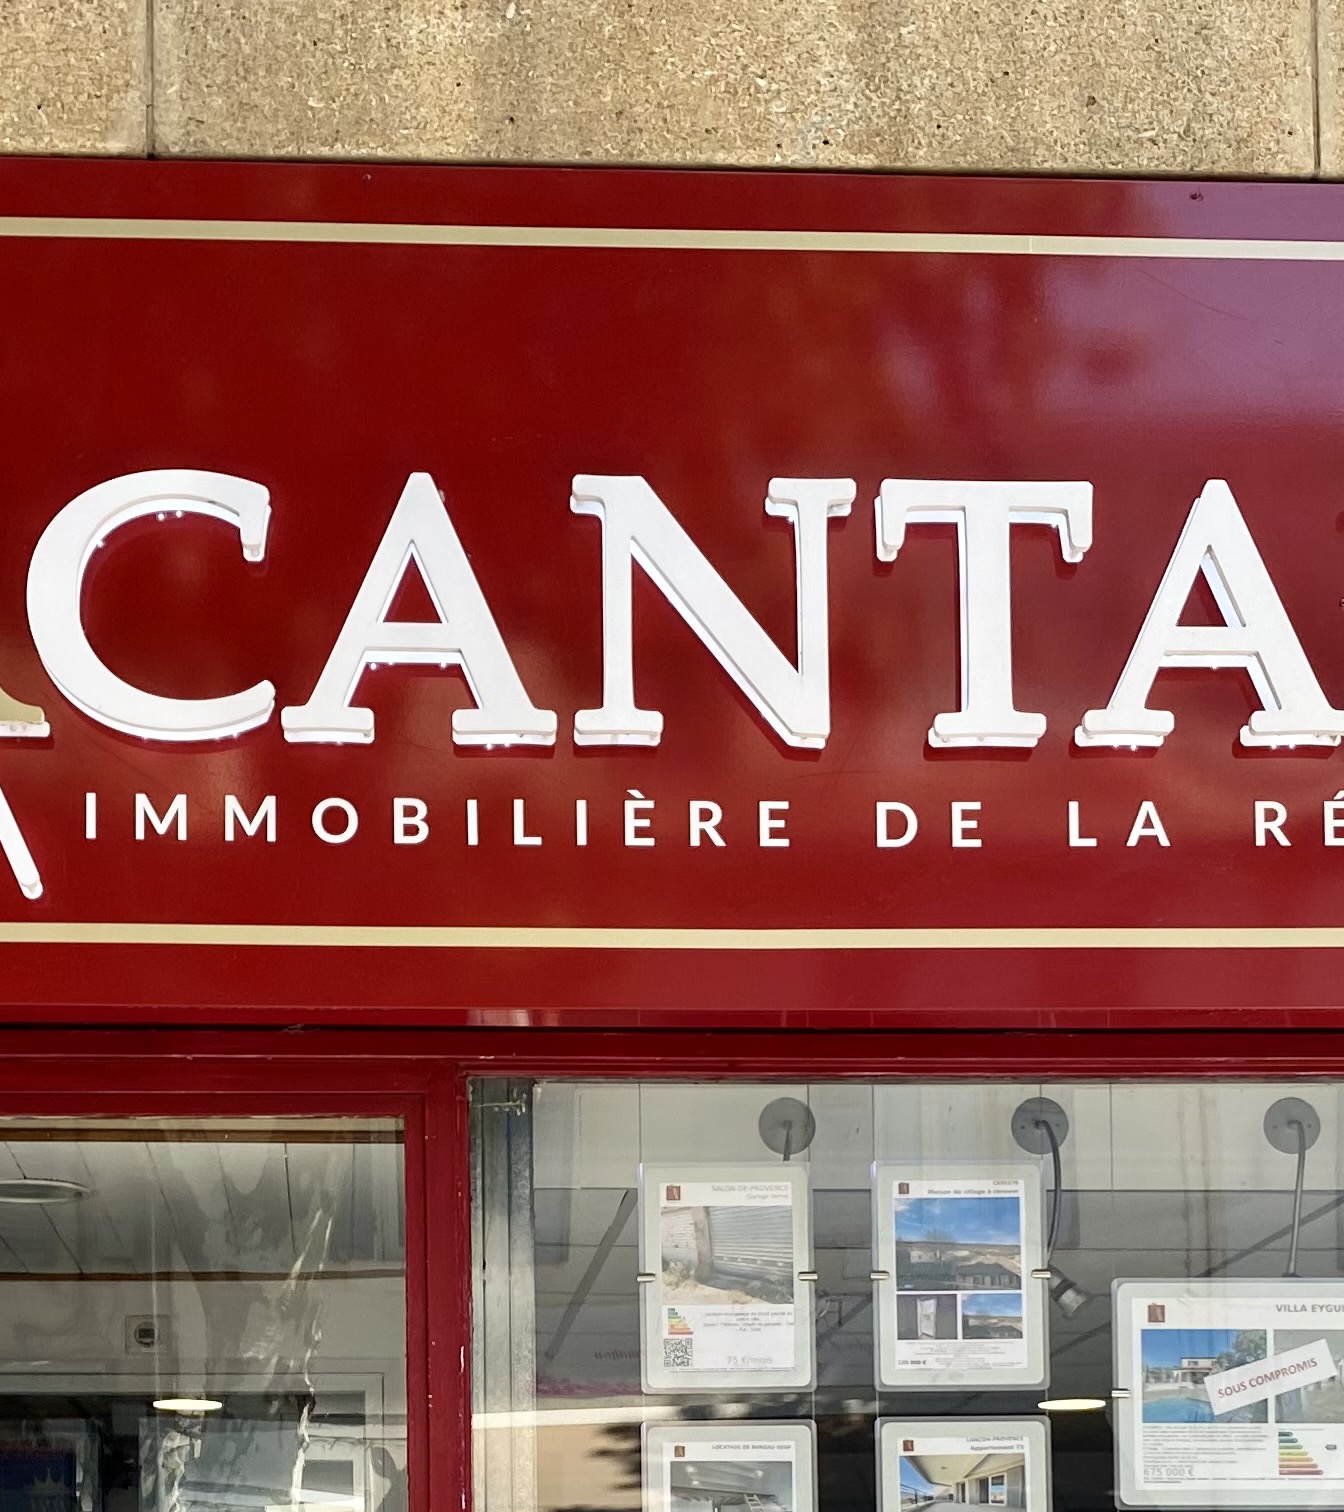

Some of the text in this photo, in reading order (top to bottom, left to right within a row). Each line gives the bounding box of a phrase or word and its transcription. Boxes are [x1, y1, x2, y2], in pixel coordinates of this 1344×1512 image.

[85, 790, 792, 849] IMMOBILIÈRE
[877, 801, 984, 849] DE
[1068, 801, 1172, 849] LA
[1275, 1303, 1308, 1313] VILLA
[1217, 1357, 1318, 1399] SOUS COMPROMIS
